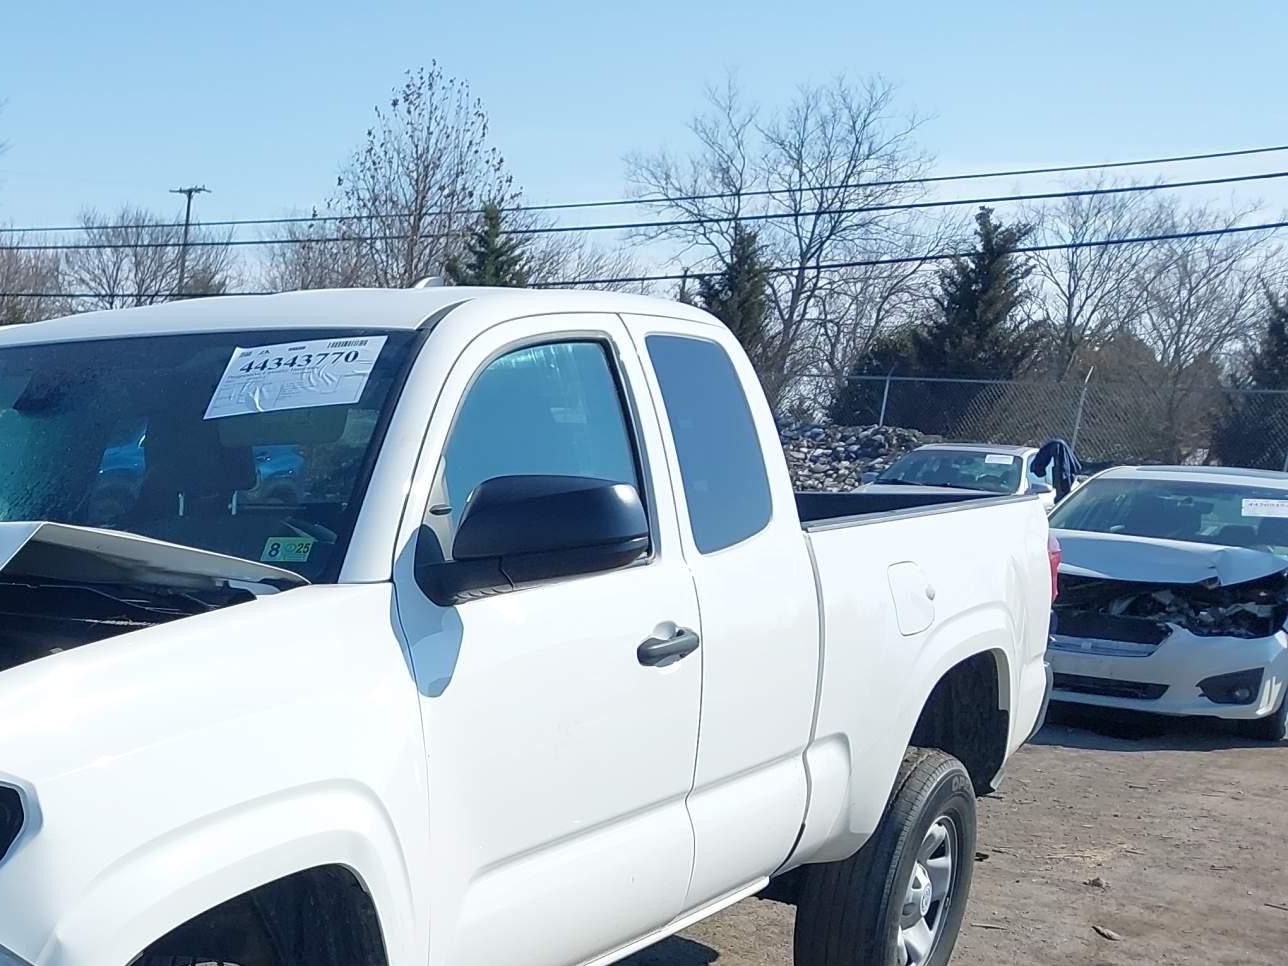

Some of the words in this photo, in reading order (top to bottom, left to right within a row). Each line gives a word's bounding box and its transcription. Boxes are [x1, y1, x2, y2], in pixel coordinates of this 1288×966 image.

[240, 350, 359, 373] 44343770
[268, 542, 281, 557] 8
[295, 542, 310, 554] 25
